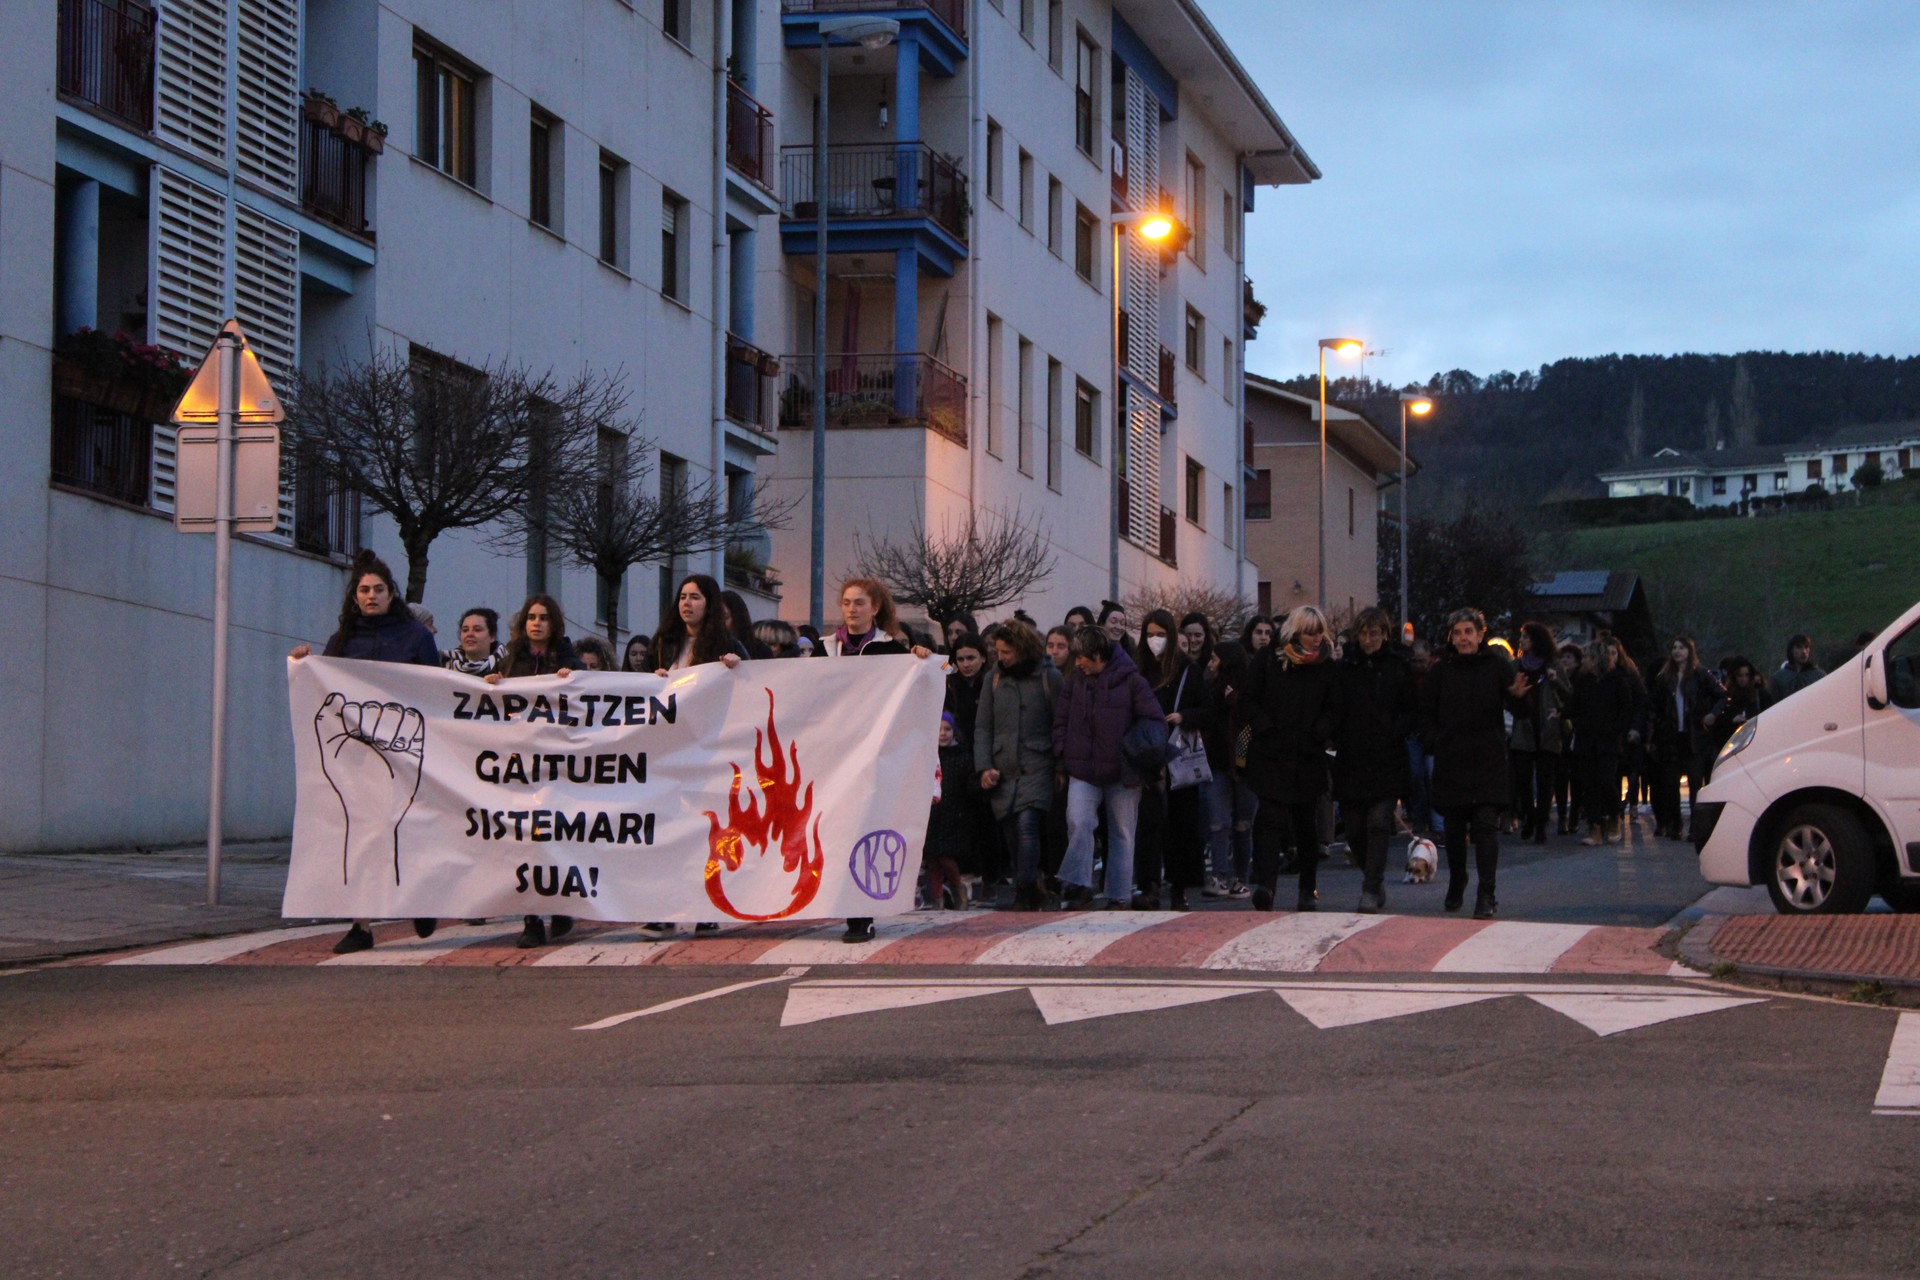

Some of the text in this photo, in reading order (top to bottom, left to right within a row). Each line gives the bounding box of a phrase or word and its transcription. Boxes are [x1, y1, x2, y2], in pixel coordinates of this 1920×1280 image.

[453, 691, 677, 727] ZAPALTZEN
[475, 750, 647, 784] GAITUEN
[465, 808, 656, 845] SISTEMARI
[515, 863, 599, 898] SUA!
